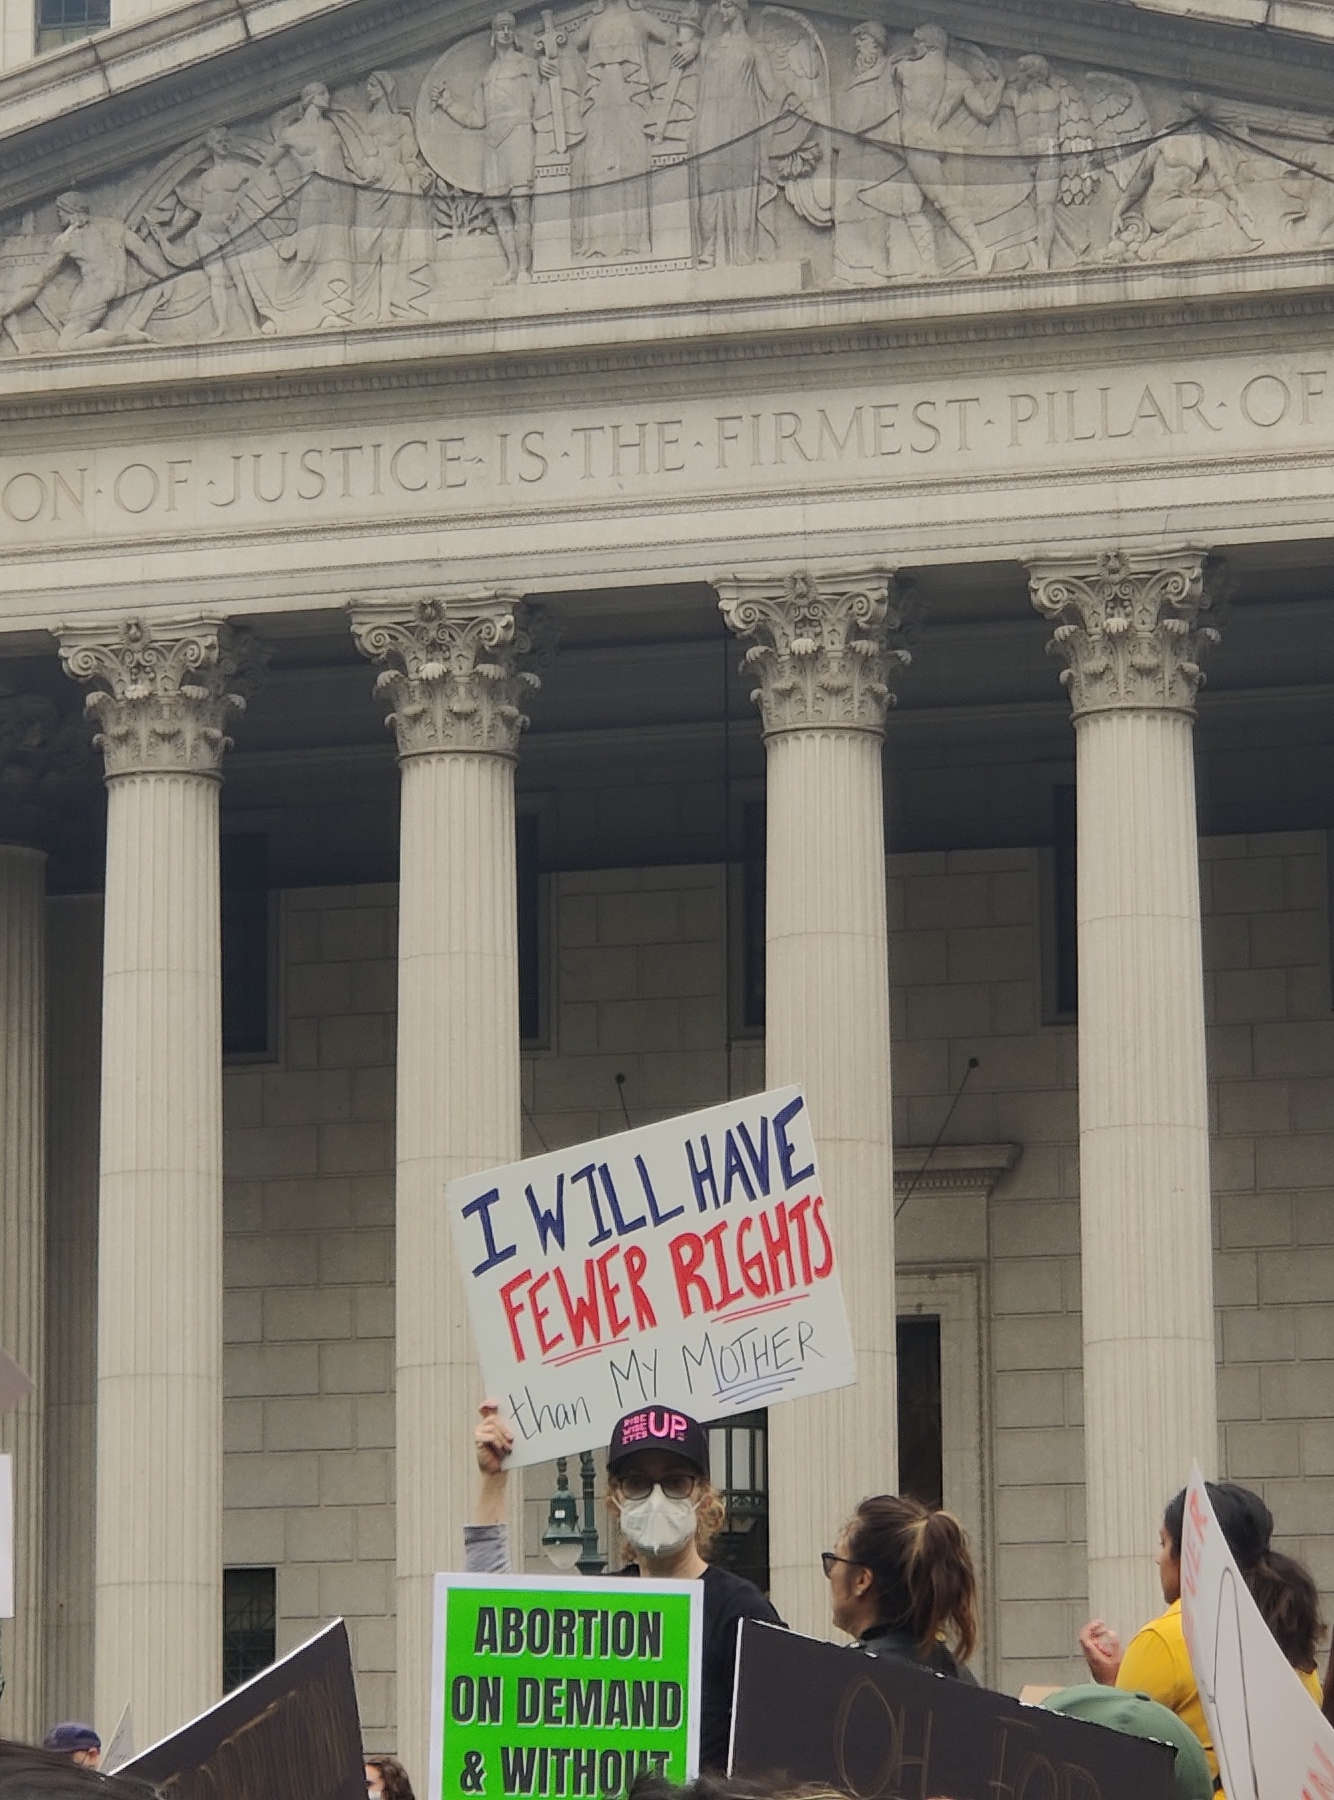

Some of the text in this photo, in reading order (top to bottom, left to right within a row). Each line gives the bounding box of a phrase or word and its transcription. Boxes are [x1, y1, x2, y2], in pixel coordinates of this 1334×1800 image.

[113, 459, 193, 514] OF
[207, 436, 468, 508] JUSTICE
[496, 430, 549, 487] IS
[571, 420, 686, 480] THE
[714, 397, 982, 470] FIRMEST
[1007, 380, 1223, 448] PILLAR
[1239, 370, 1328, 429] OF
[461, 1095, 816, 1278] I WILL HAVE
[498, 1193, 835, 1364] FEWER RIGHTS
[508, 1384, 592, 1441] than
[681, 1320, 826, 1395] MOTHER
[648, 1410, 688, 1439] UP
[474, 1606, 663, 1661] ABORTION
[451, 1675, 684, 1731] ON DEMAND
[459, 1750, 487, 1796] &
